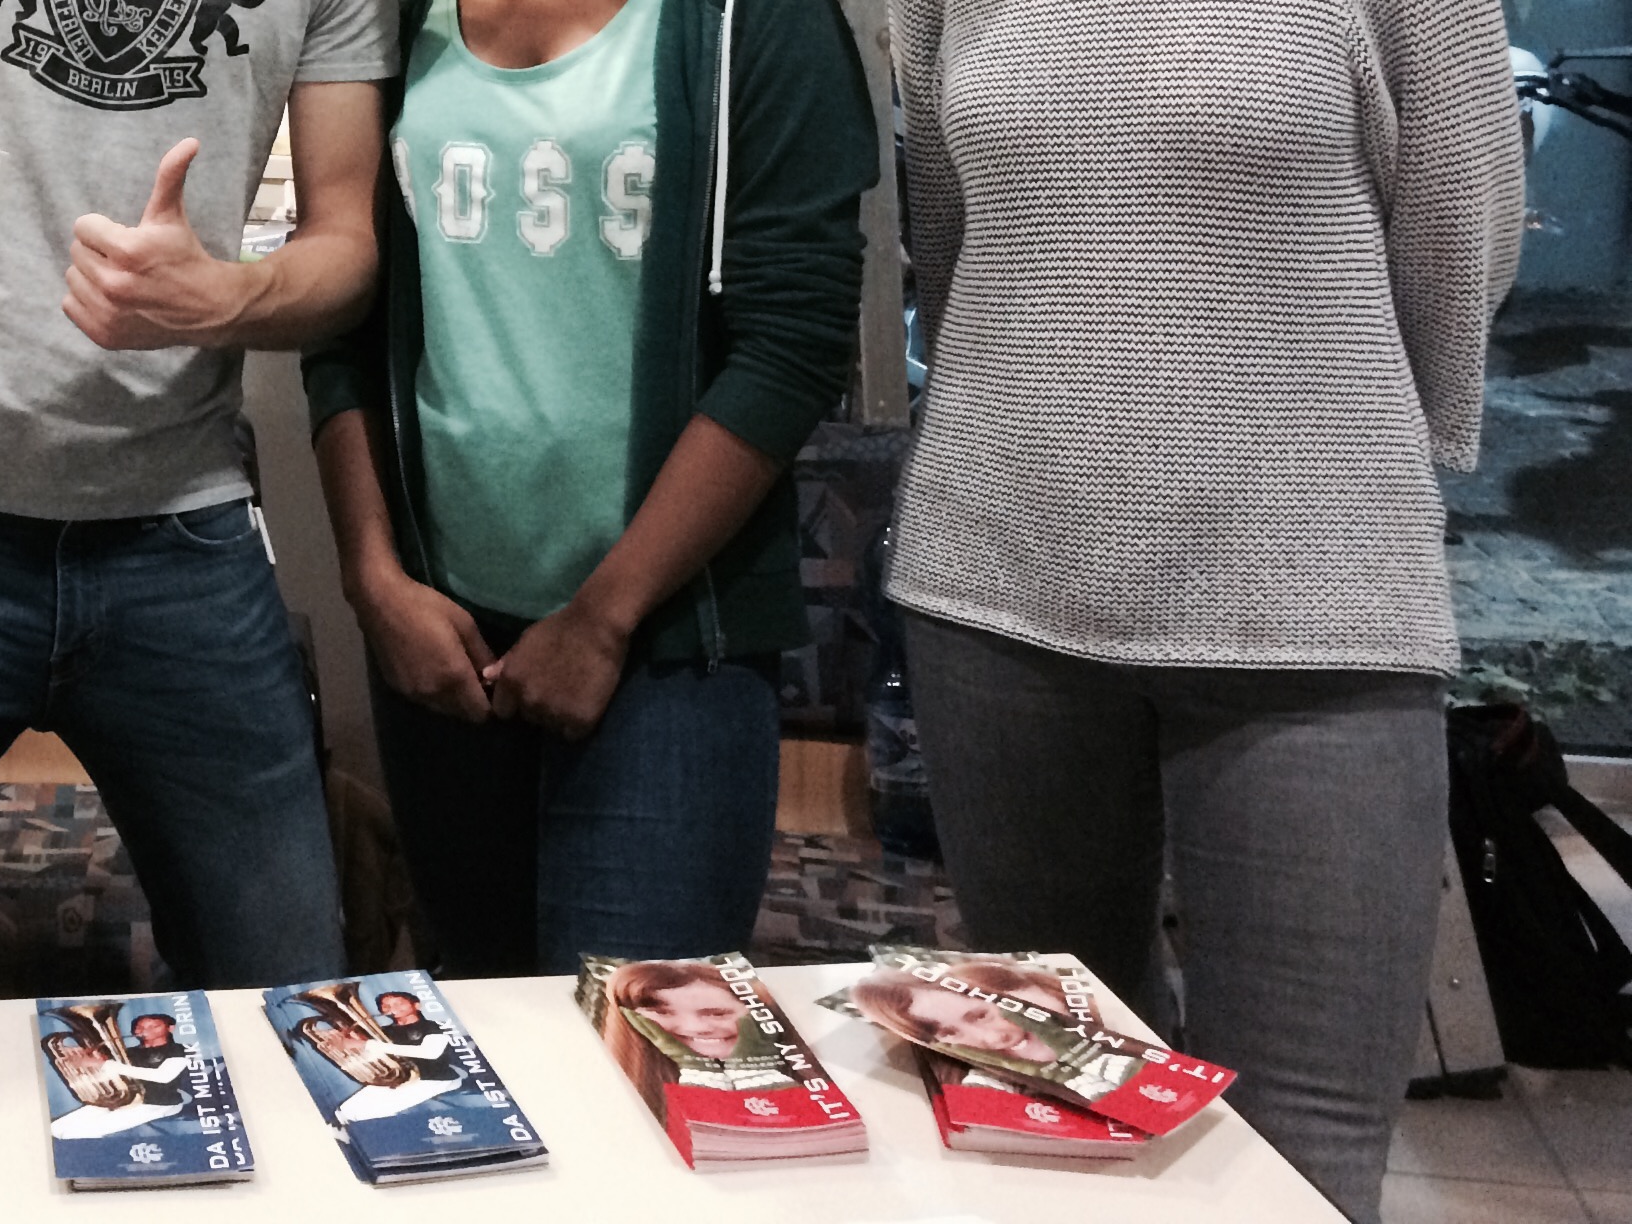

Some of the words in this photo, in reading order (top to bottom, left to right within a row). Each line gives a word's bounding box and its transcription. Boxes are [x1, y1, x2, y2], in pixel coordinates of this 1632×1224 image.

[24, 40, 48, 62] 19
[66, 68, 139, 99] BERLIN
[405, 972, 445, 1013] DRIN
[715, 957, 785, 1036] SCHOOL
[171, 994, 197, 1036] DRIN
[438, 1018, 487, 1074] MUSIK
[1064, 1024, 1126, 1049] MY
[183, 1041, 213, 1099] MUSIK
[773, 1042, 813, 1071] MY
[1141, 1048, 1225, 1084] IT'S
[476, 1079, 511, 1109] IST
[803, 1077, 851, 1119] IT'S
[196, 1104, 222, 1135] IST
[503, 1114, 533, 1142] DA
[208, 1141, 230, 1169] DA
